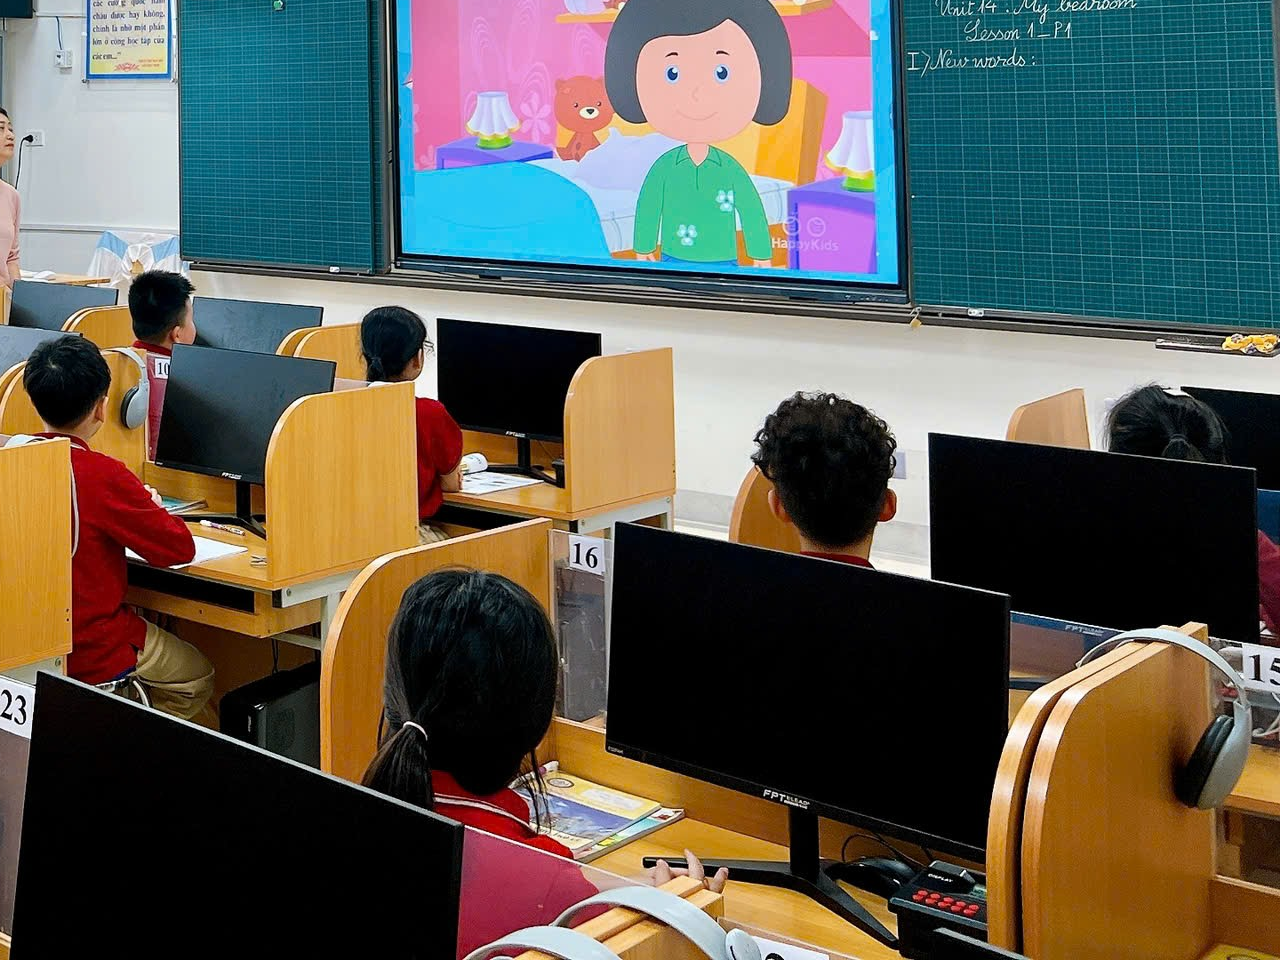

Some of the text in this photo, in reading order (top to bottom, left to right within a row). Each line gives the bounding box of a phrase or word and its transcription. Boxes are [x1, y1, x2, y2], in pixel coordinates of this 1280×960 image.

[128, 11, 140, 20] hay
[977, 0, 997, 14] 14
[963, 20, 1020, 41] Lesson
[158, 362, 170, 376] 10
[572, 543, 599, 569] 16
[1249, 654, 1280, 686] 15
[0, 689, 27, 725] 23
[763, 789, 786, 802] FPT
